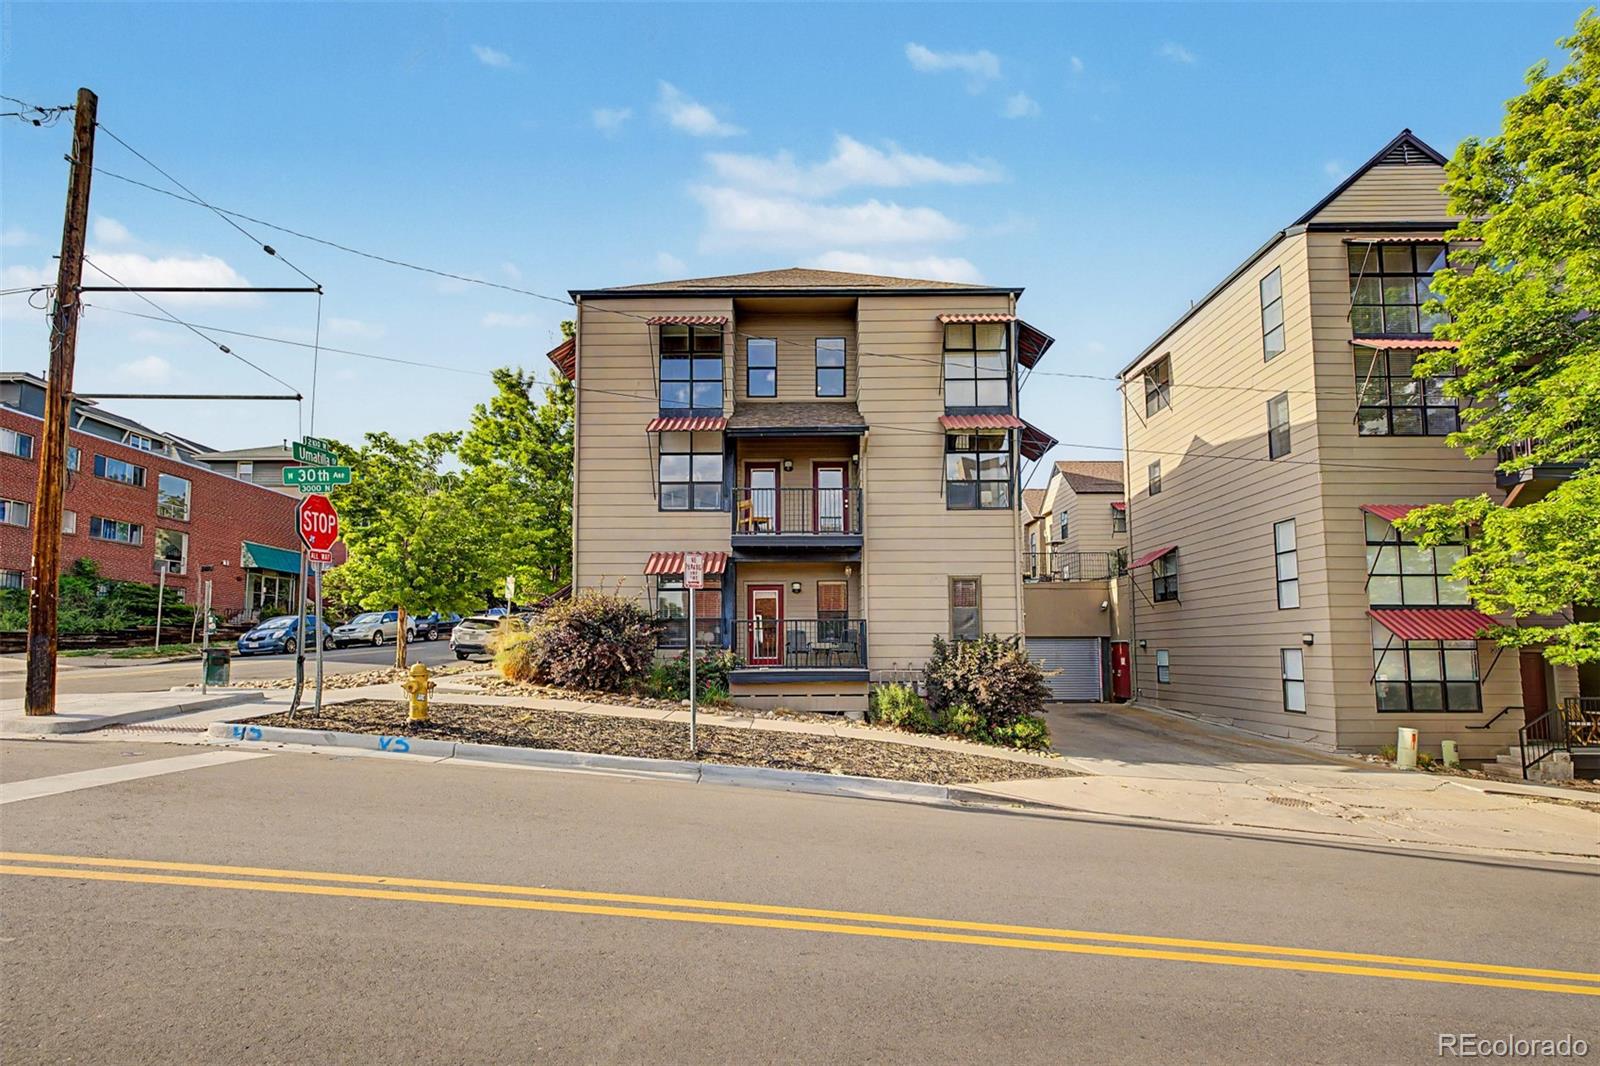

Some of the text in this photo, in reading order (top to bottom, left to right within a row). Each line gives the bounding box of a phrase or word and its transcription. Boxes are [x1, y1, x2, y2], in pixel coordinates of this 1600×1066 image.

[299, 446, 330, 466] Umatilla
[298, 469, 330, 482] 30th
[303, 510, 336, 534] STOP
